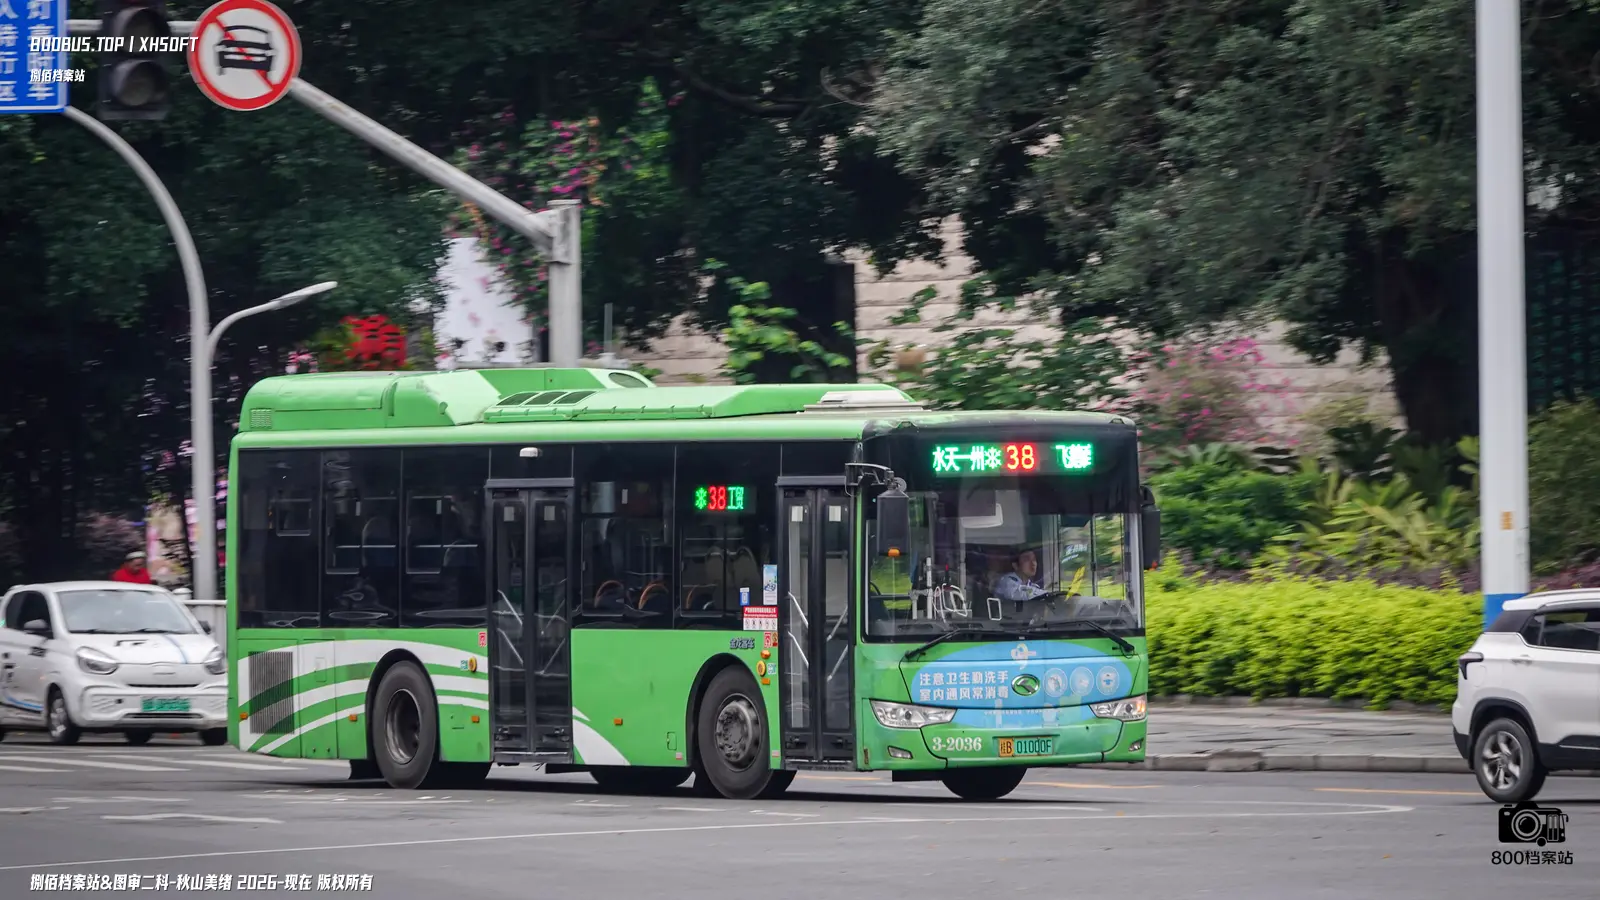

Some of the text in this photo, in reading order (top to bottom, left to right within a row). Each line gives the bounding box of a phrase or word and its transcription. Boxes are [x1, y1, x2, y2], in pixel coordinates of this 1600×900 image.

[932, 445, 985, 472] 水天一州
[1006, 444, 1034, 470] 38
[707, 485, 726, 510] 38
[919, 670, 1009, 686] 注意卫生勤洗手
[919, 686, 1009, 702] 室内通风常消毒
[932, 736, 982, 752] 3-2036
